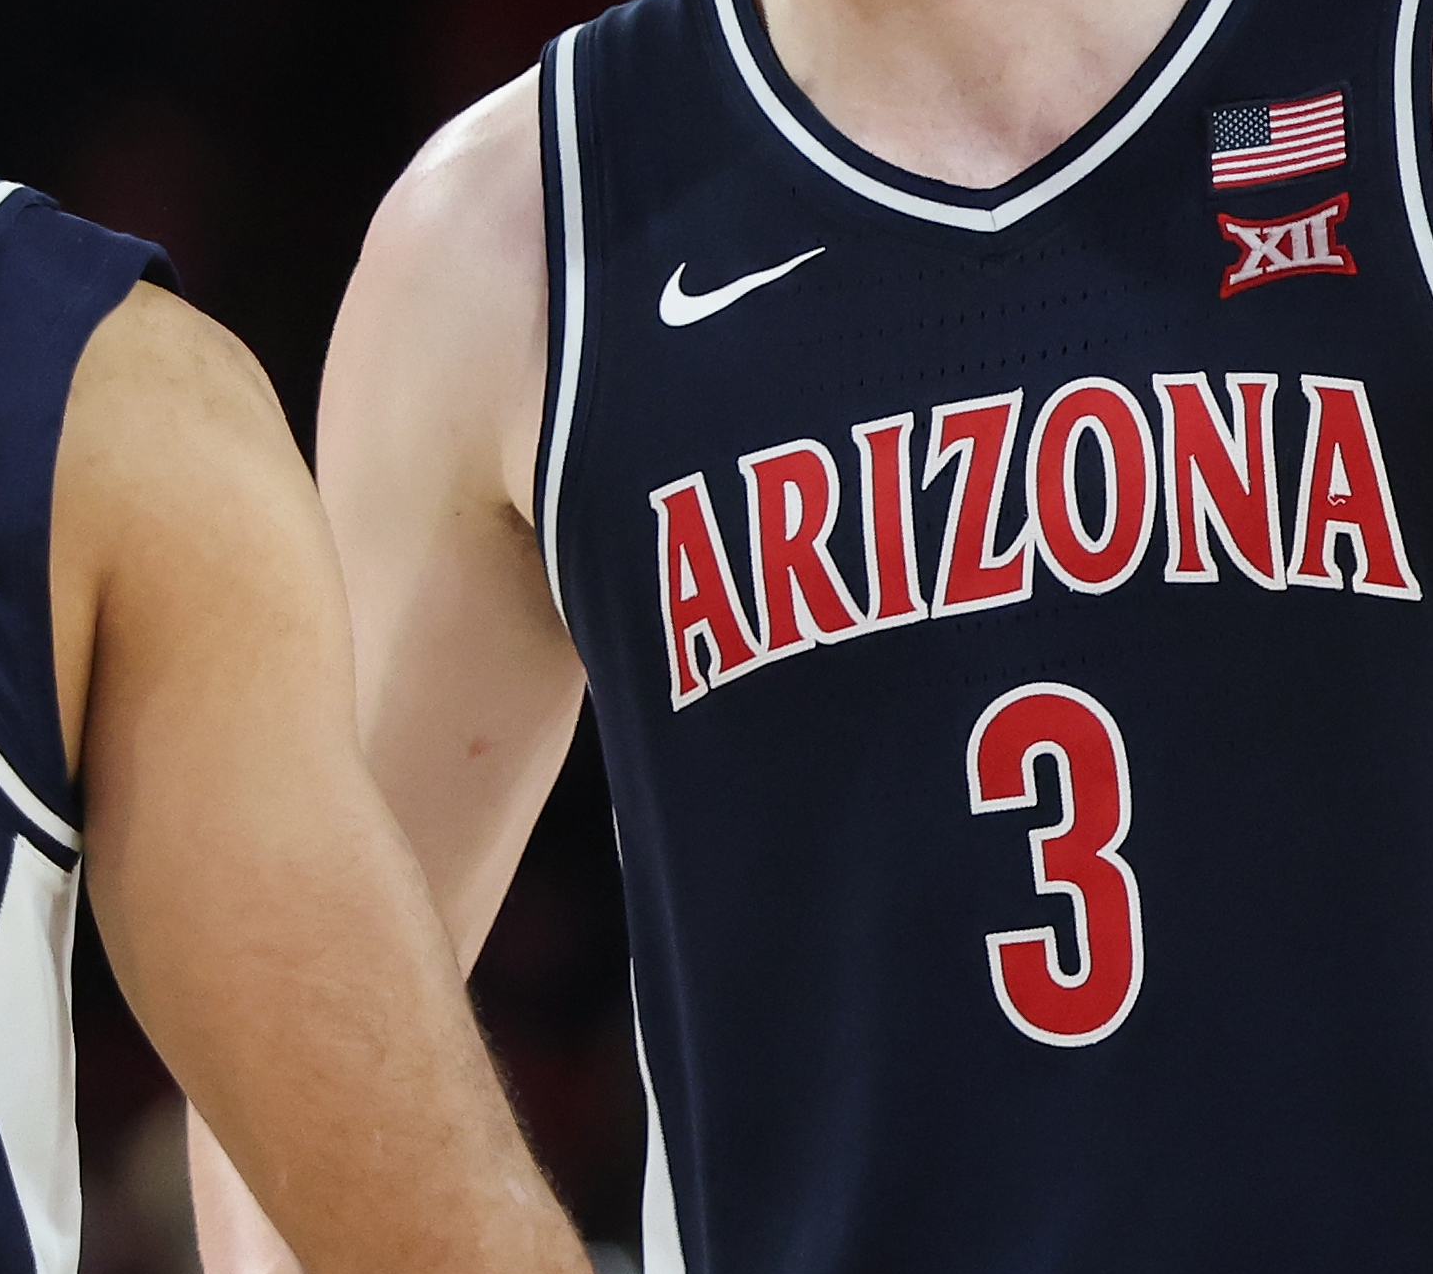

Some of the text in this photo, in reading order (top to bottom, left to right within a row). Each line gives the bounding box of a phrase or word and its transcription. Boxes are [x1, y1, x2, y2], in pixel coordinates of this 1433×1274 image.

[1225, 204, 1345, 286] XII
[648, 371, 1423, 713] ARIZONA
[966, 681, 1145, 1048] 3
